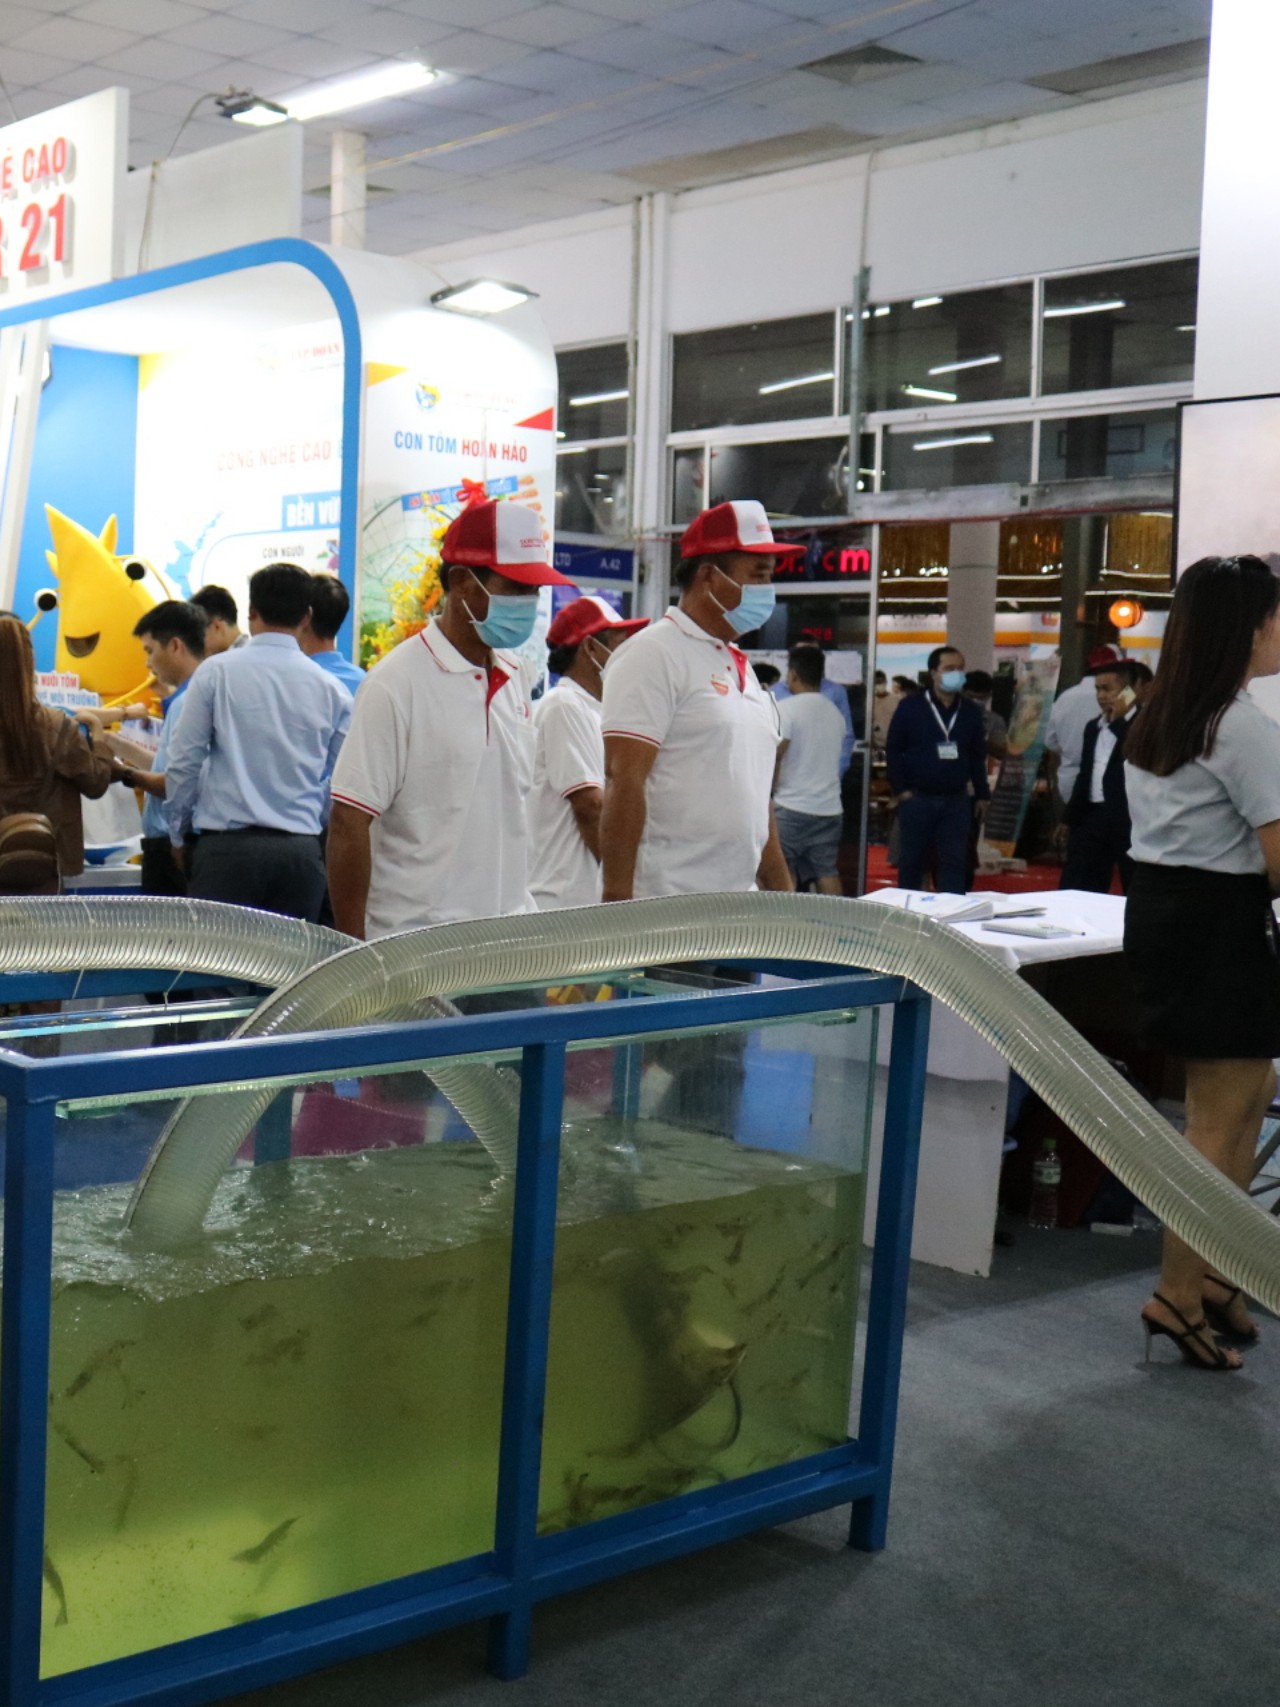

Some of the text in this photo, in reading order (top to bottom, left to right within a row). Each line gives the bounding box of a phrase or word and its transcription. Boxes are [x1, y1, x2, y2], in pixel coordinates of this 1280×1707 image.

[23, 136, 67, 183] CAO
[20, 194, 65, 271] 21
[302, 440, 332, 462] CAO
[394, 430, 423, 451] CON
[600, 557, 621, 570] A.42
